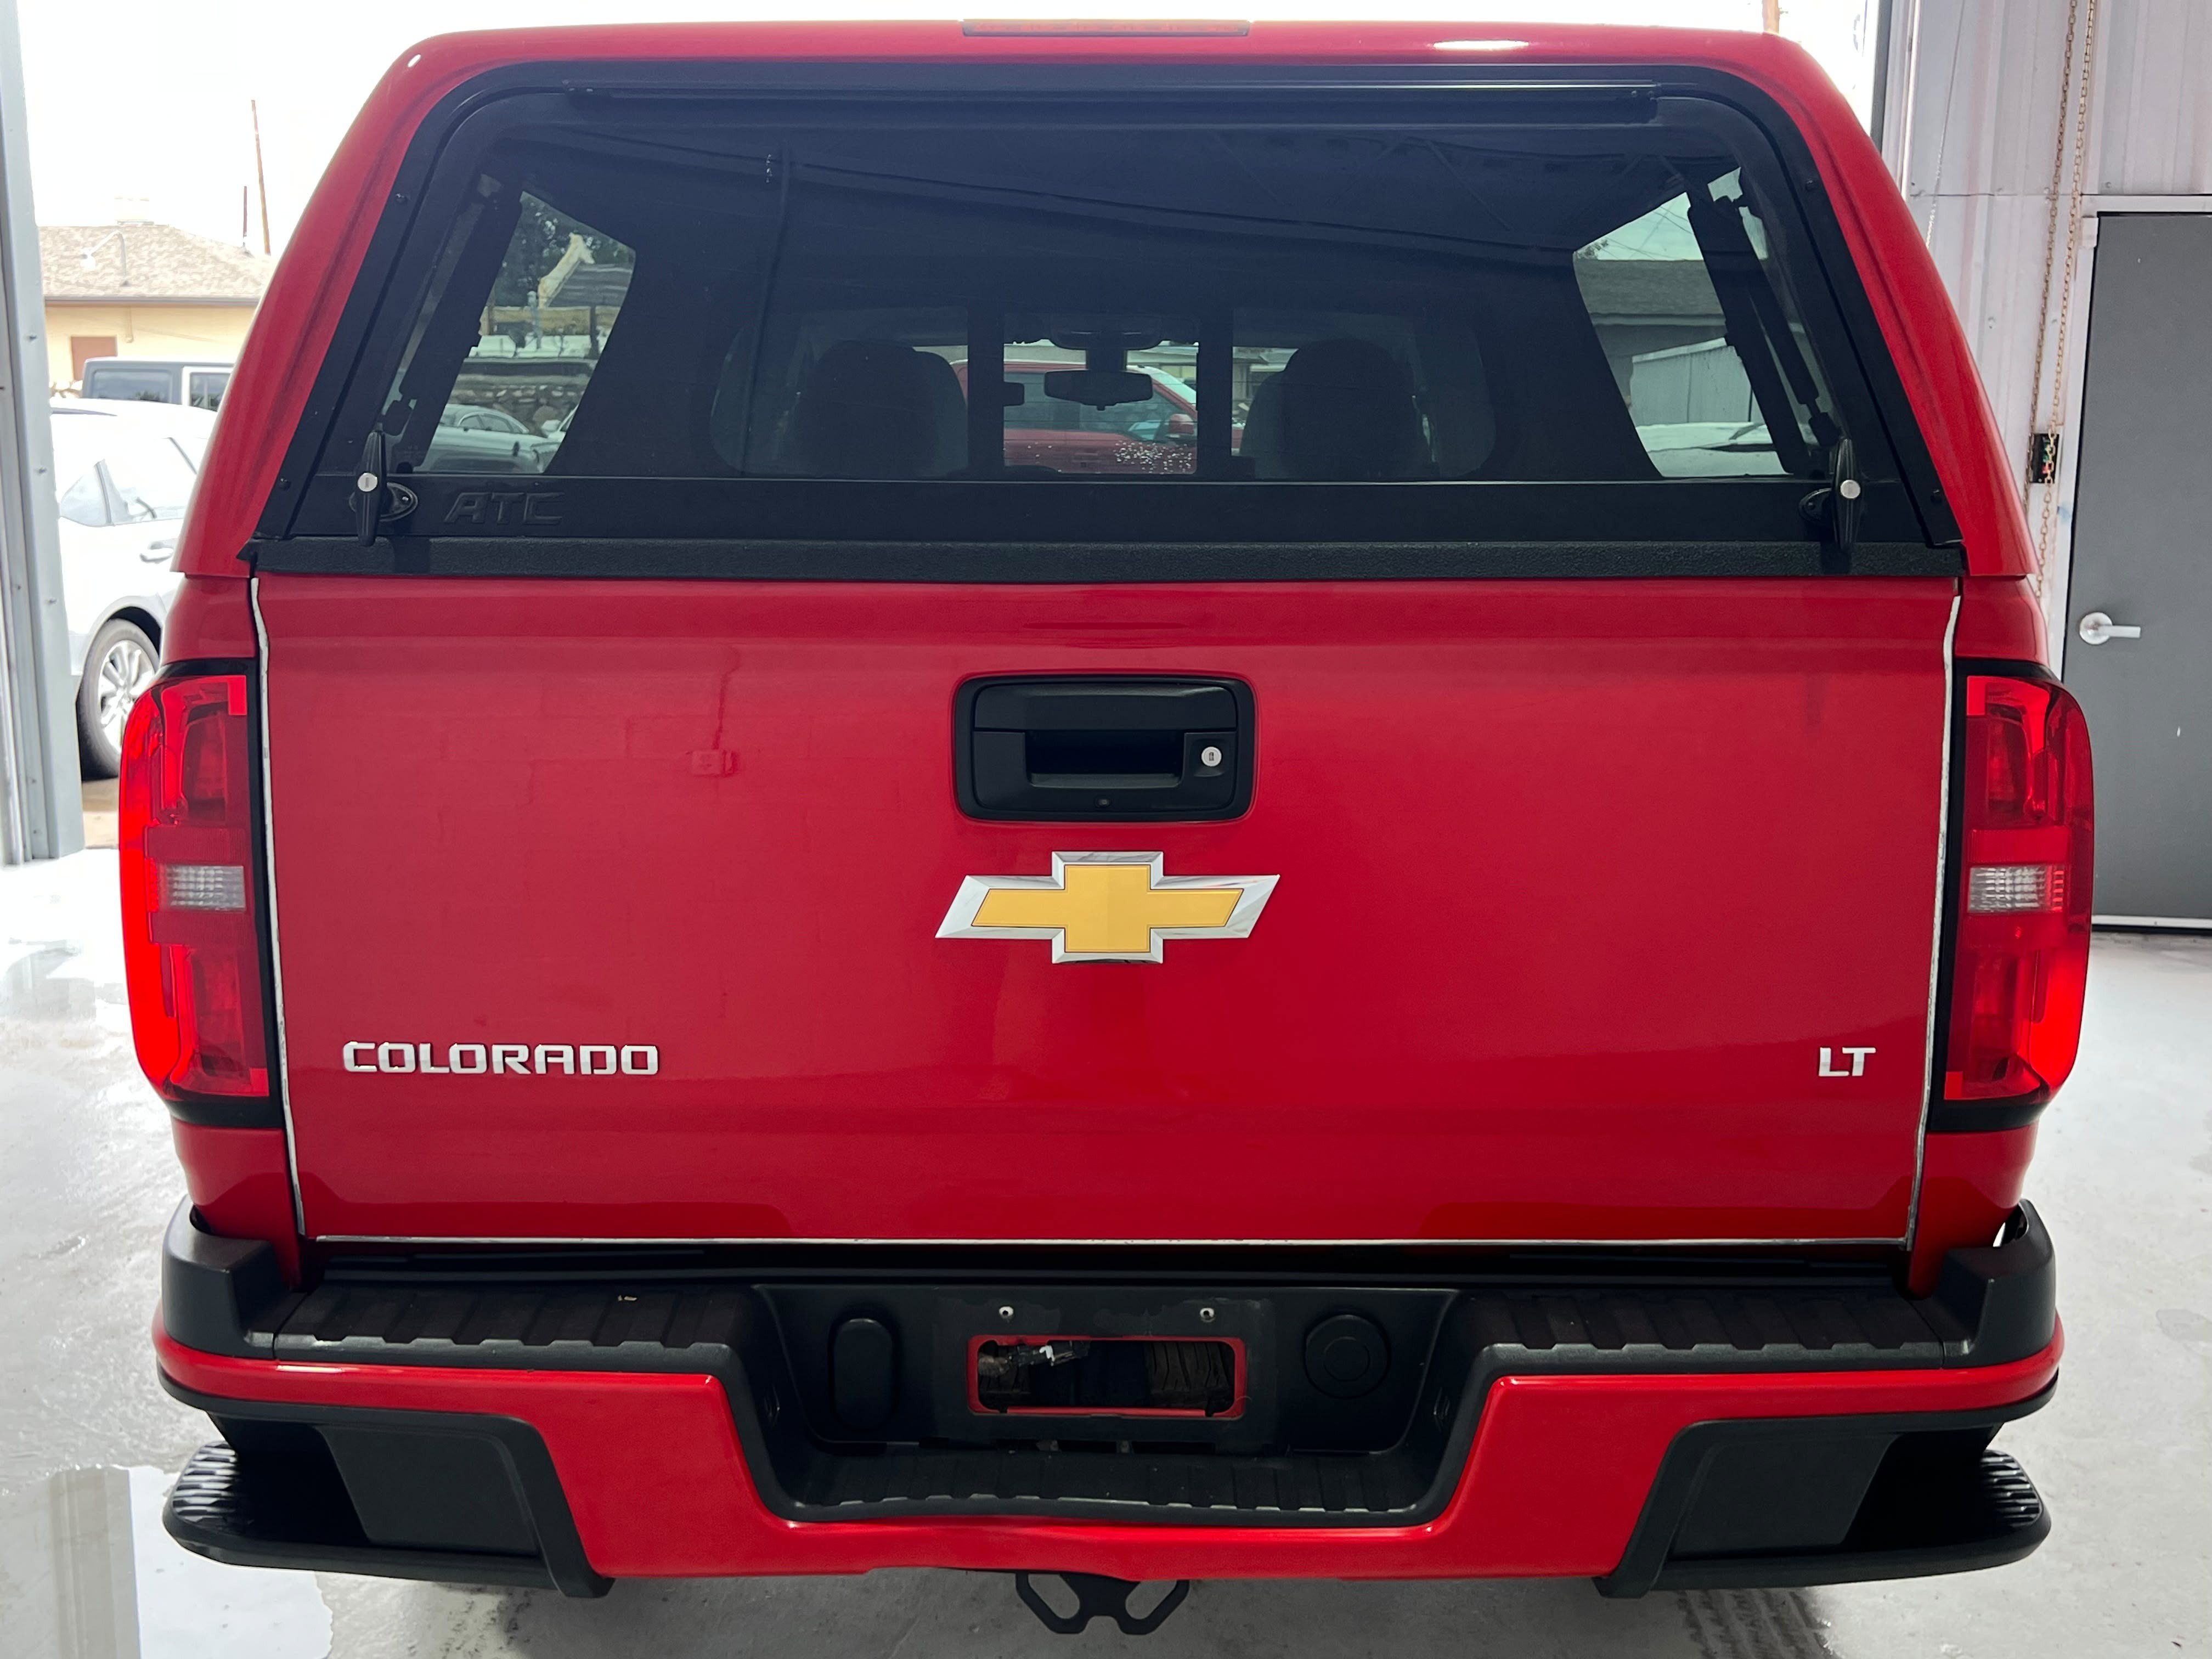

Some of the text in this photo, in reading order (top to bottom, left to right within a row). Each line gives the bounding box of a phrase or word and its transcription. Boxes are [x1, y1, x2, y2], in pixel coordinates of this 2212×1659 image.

[443, 492, 565, 526] ATC
[342, 1041, 658, 1075] COLORADO
[1818, 1047, 1876, 1076] LT
